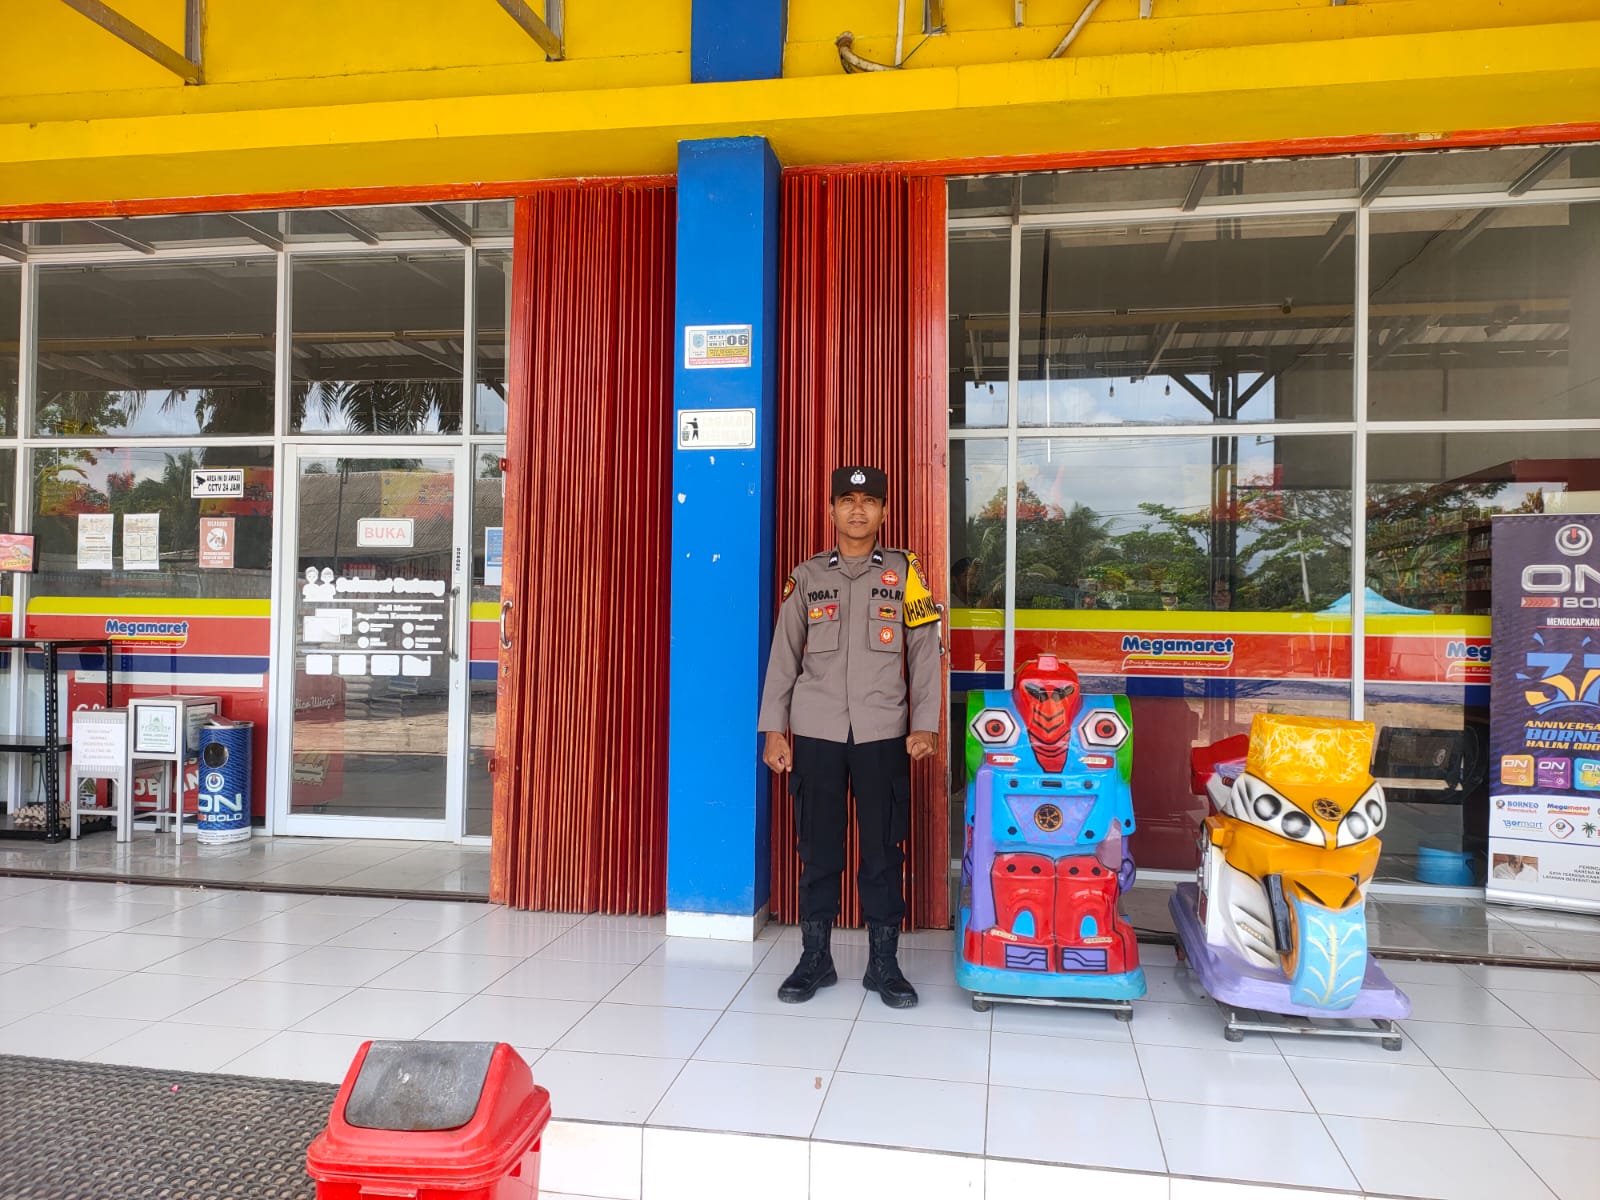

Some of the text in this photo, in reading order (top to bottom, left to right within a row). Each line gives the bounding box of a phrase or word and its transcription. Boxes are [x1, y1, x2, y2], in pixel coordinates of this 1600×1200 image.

[727, 334, 748, 346] 06
[207, 482, 221, 492] CCTV
[230, 482, 241, 492] JAM
[364, 527, 406, 540] BUKA
[808, 589, 839, 602] YOGA.T
[871, 588, 904, 601] POLRI
[1562, 596, 1600, 609] BO
[105, 619, 189, 637] Megamaret
[1546, 617, 1600, 626] MENGUCAPKAN
[1122, 635, 1235, 656] Megamaret
[1446, 641, 1492, 663] Meg
[1525, 740, 1570, 749] HALIM
[1503, 760, 1528, 768] ON
[1538, 761, 1566, 770] ON
[198, 793, 242, 813] ON
[207, 813, 243, 822] BOLD
